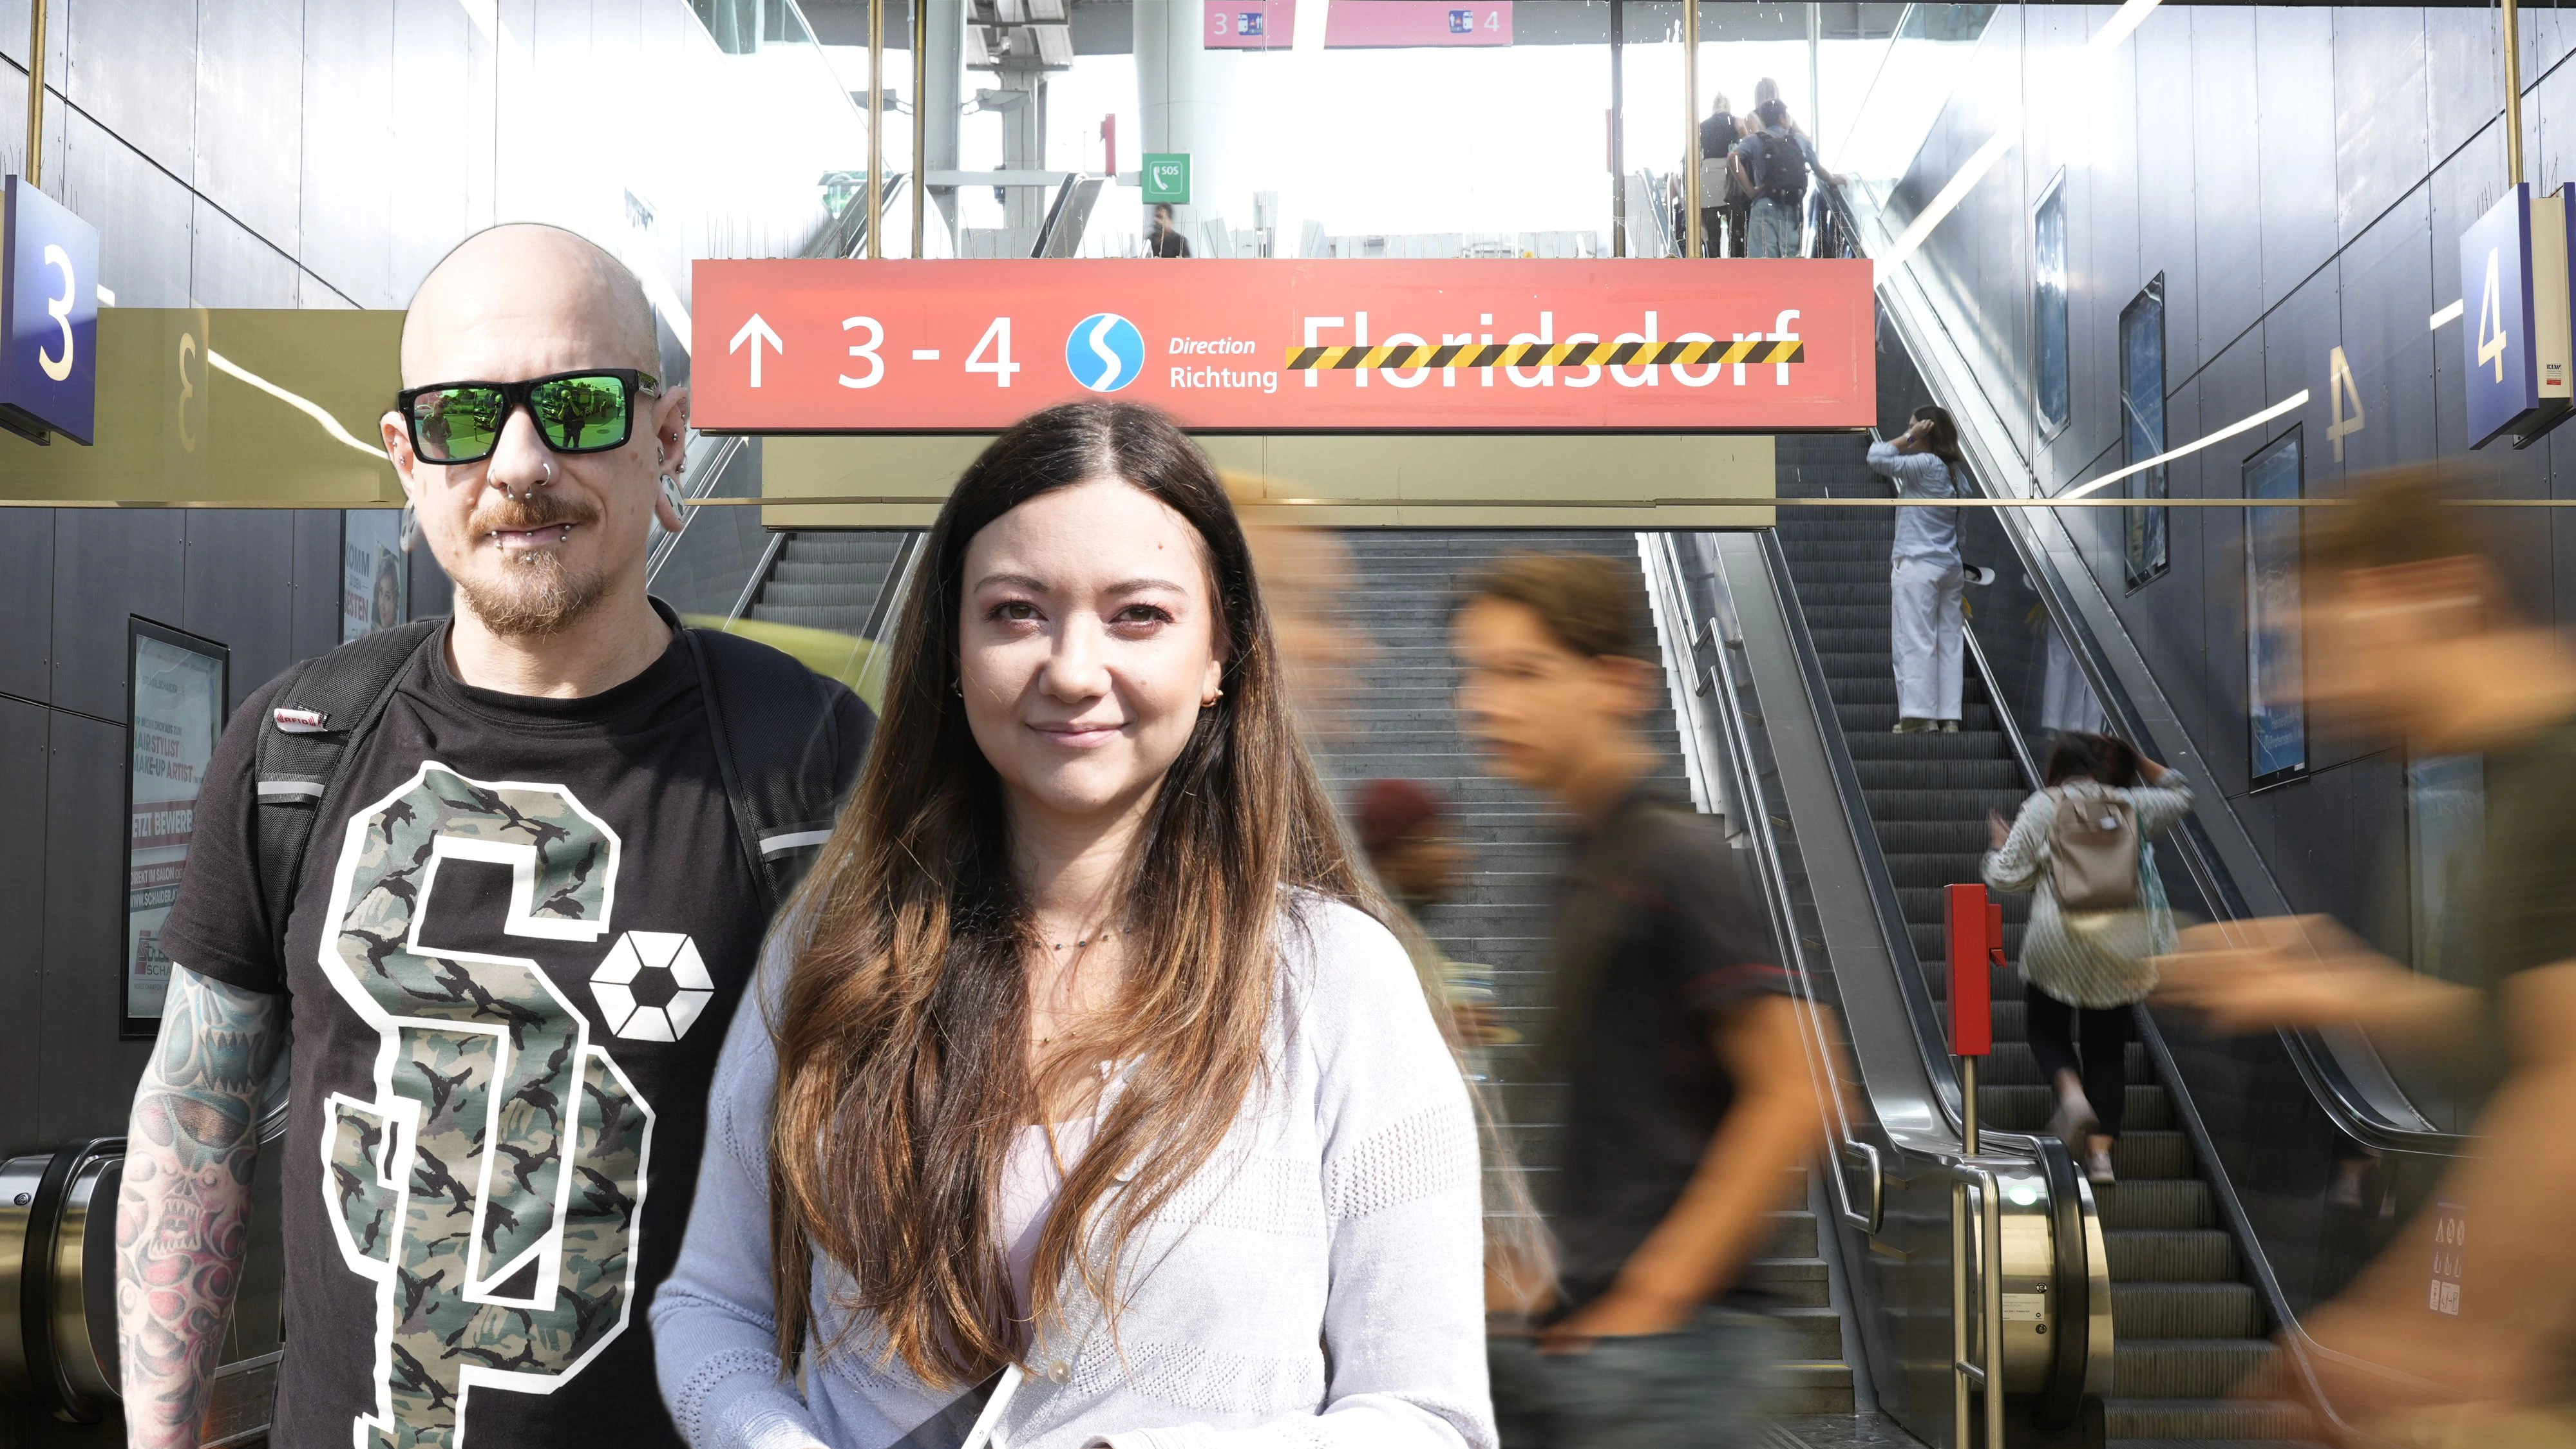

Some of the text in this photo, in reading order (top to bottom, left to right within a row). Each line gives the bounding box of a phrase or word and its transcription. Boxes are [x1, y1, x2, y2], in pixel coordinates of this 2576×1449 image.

[1213, 13, 1227, 35] 3
[1483, 11, 1501, 32] 4
[1161, 166, 1179, 175] SOS
[39, 244, 75, 381] 3
[2477, 247, 2506, 384] 4
[838, 316, 1021, 389] 3 - 4
[1169, 336, 1256, 355] Direction
[1303, 309, 1801, 389] Floridsdorf
[1171, 365, 1278, 394] Richtung
[284, 717, 308, 725] RFID
[151, 735, 180, 759] STYLIST
[167, 761, 193, 784] ARTIST
[133, 809, 193, 838] ETZT BEWERB
[156, 866, 175, 882] SALON
